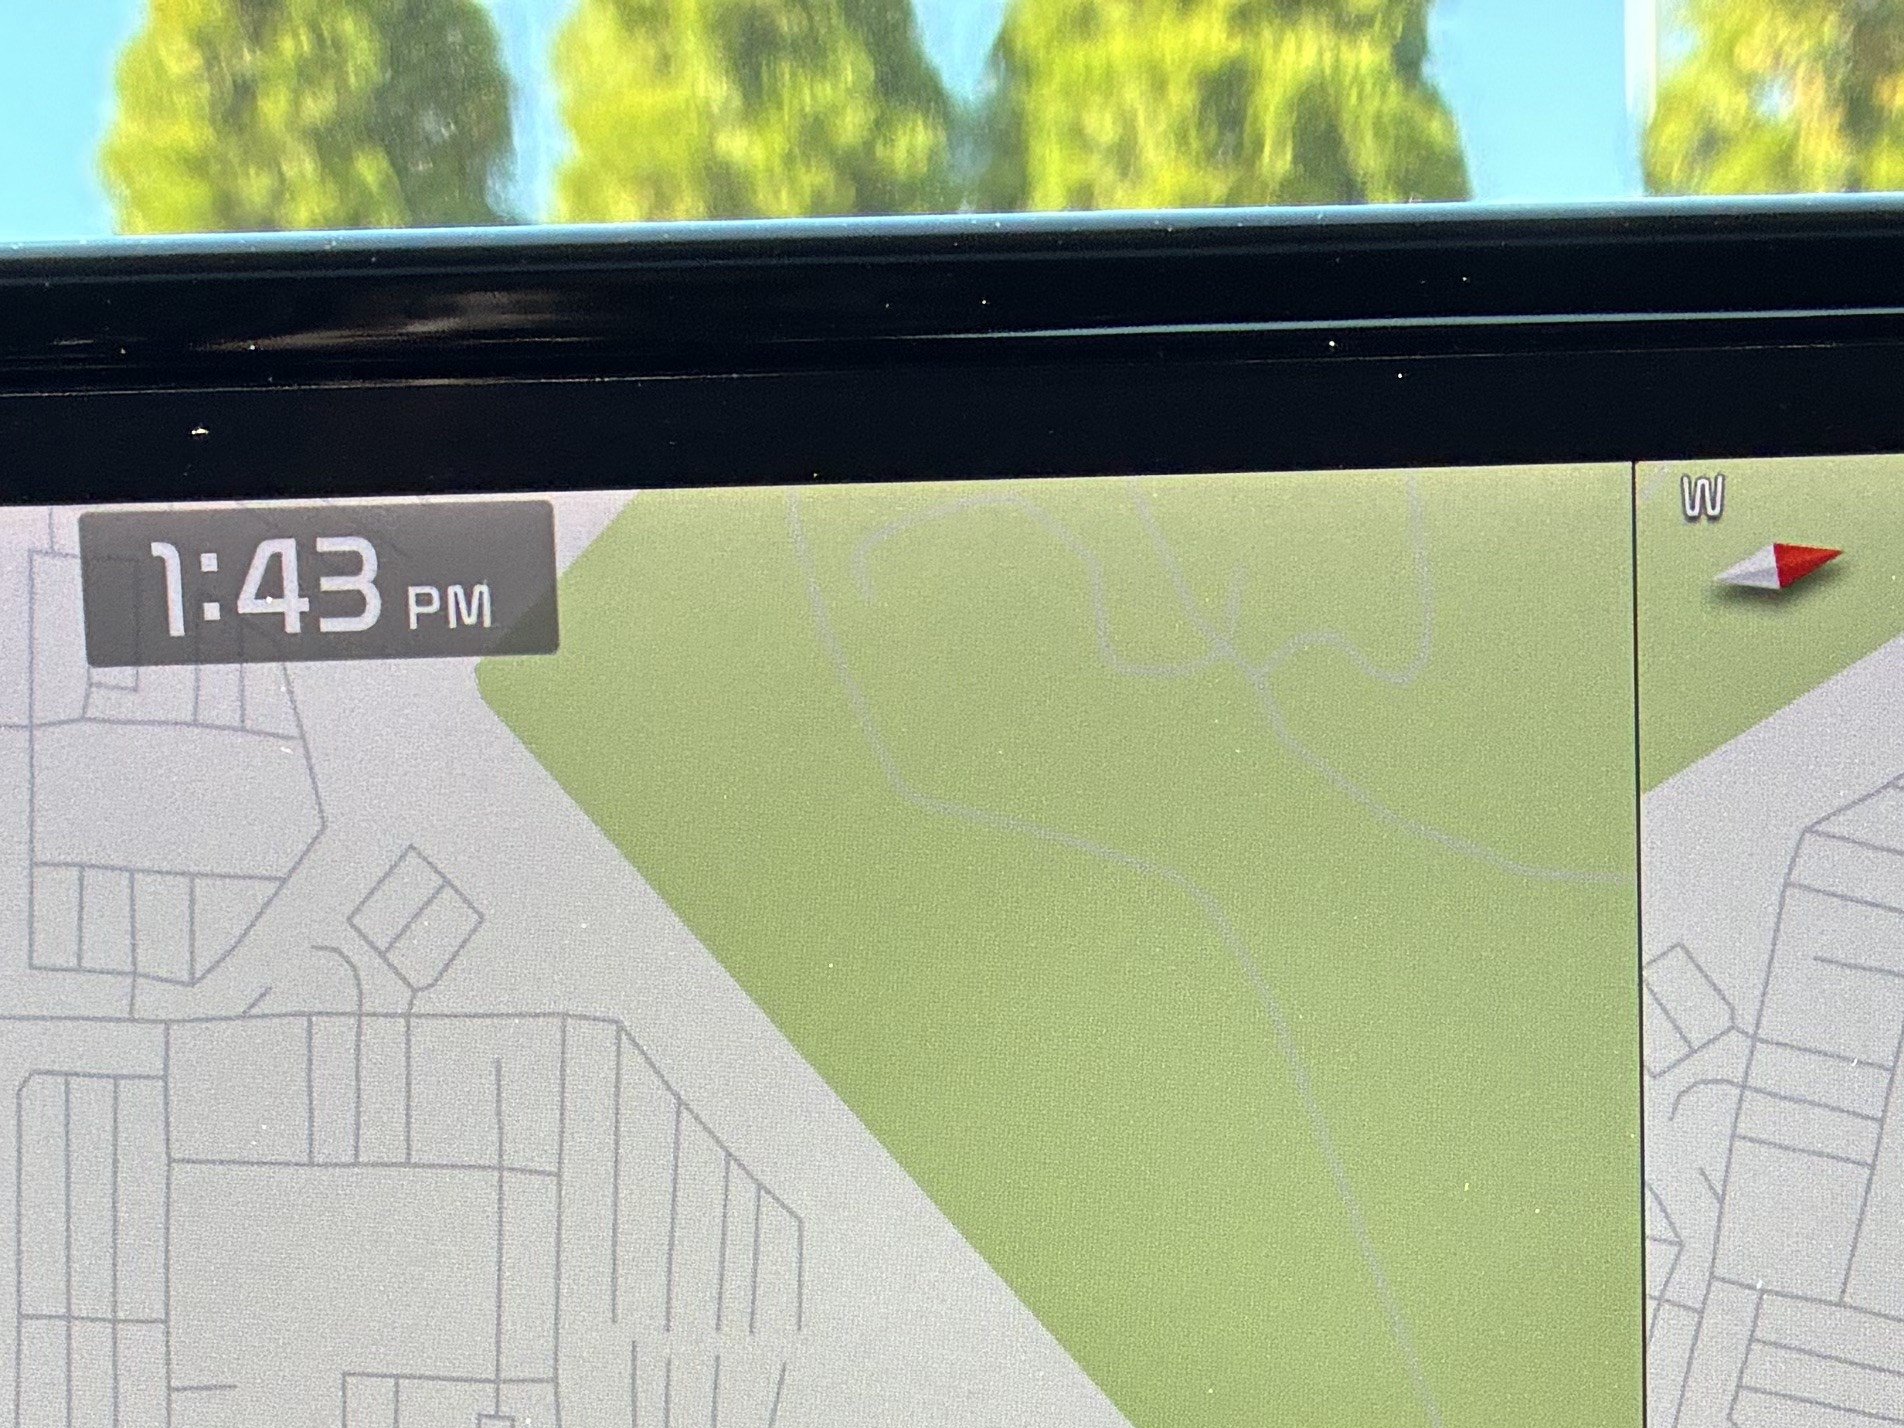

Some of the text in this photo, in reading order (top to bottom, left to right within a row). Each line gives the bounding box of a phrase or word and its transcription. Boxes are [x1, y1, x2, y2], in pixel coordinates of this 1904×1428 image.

[1680, 472, 1726, 521] W
[149, 535, 493, 638] 1:43 PM
